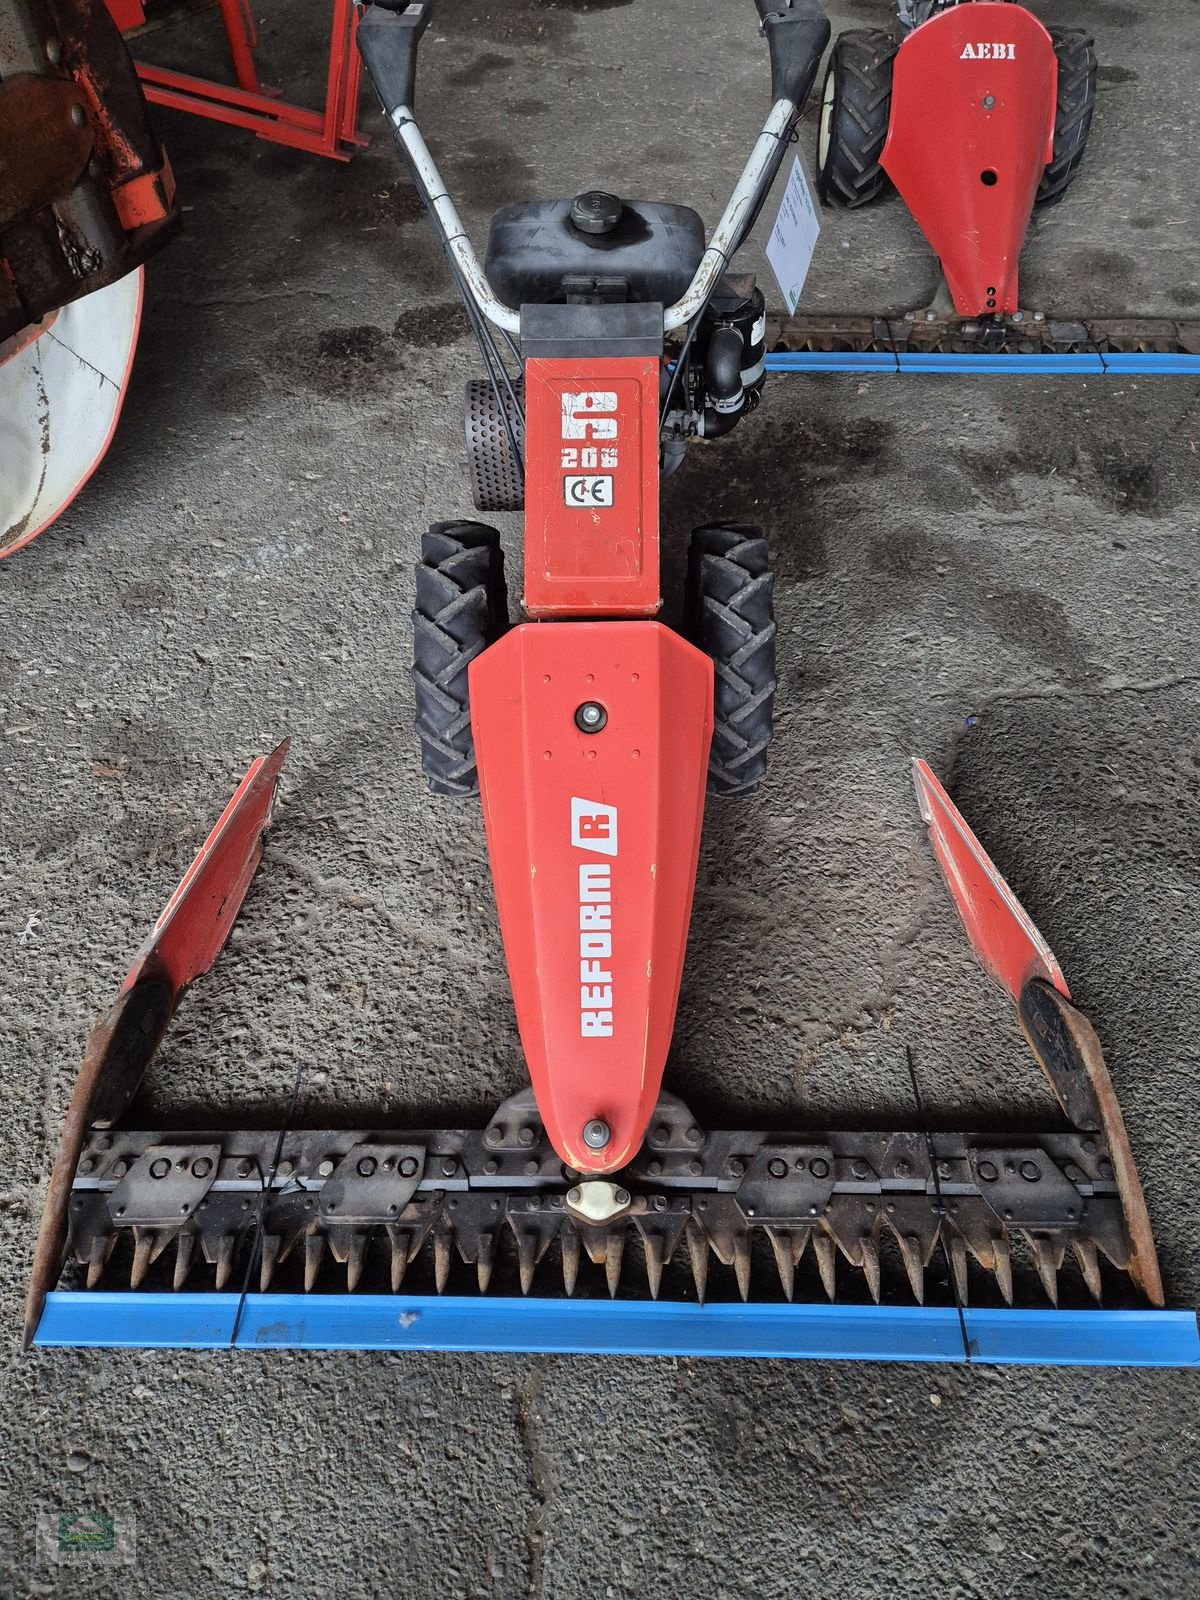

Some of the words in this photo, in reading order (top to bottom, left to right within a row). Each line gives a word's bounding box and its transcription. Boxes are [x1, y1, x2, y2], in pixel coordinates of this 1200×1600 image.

[959, 42, 1016, 60] AEBI
[571, 479, 605, 503] CE
[579, 863, 614, 1037] REFORM
